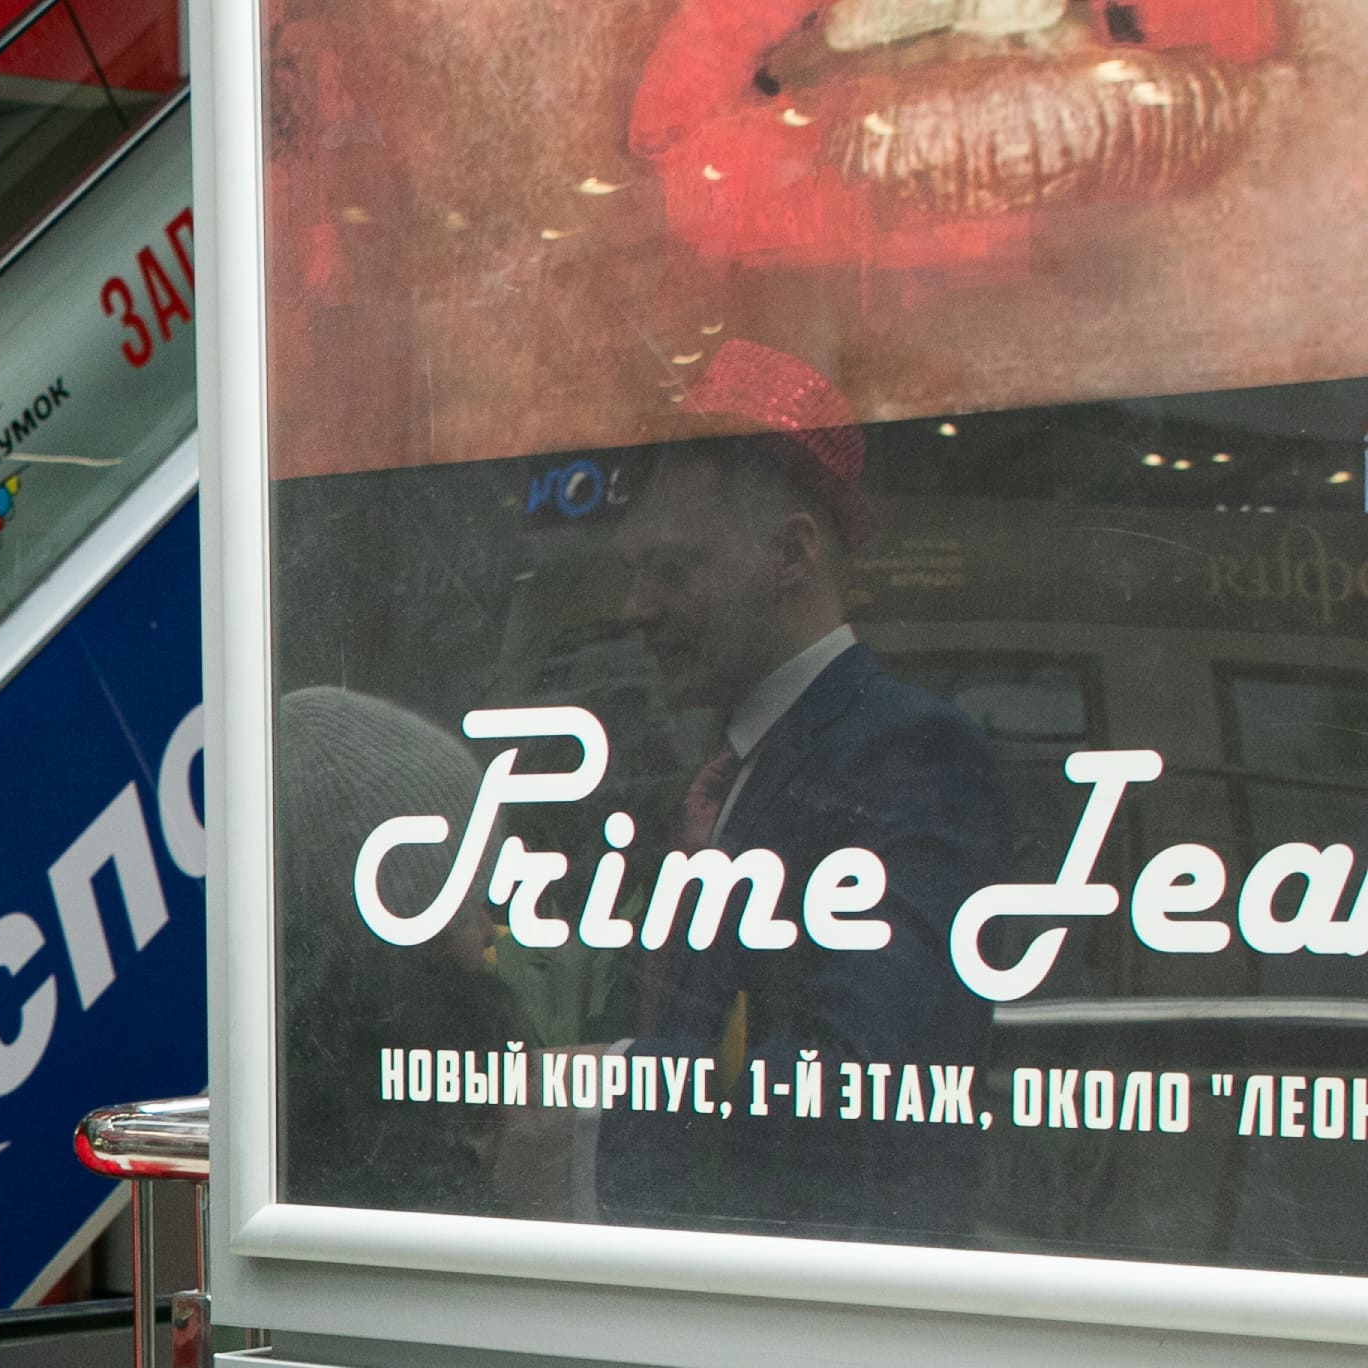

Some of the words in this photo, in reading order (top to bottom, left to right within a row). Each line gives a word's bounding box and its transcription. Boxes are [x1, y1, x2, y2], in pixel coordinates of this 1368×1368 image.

[353, 705, 893, 951] Prime
[949, 749, 1368, 1001] Jea
[380, 1041, 528, 1106] НОВЫЙ
[541, 1053, 734, 1120] КОРПУС,
[749, 1049, 823, 1119] 1-Й
[839, 1062, 995, 1131] ЭТАЖ,
[1011, 1067, 1191, 1133] ОКОЛО
